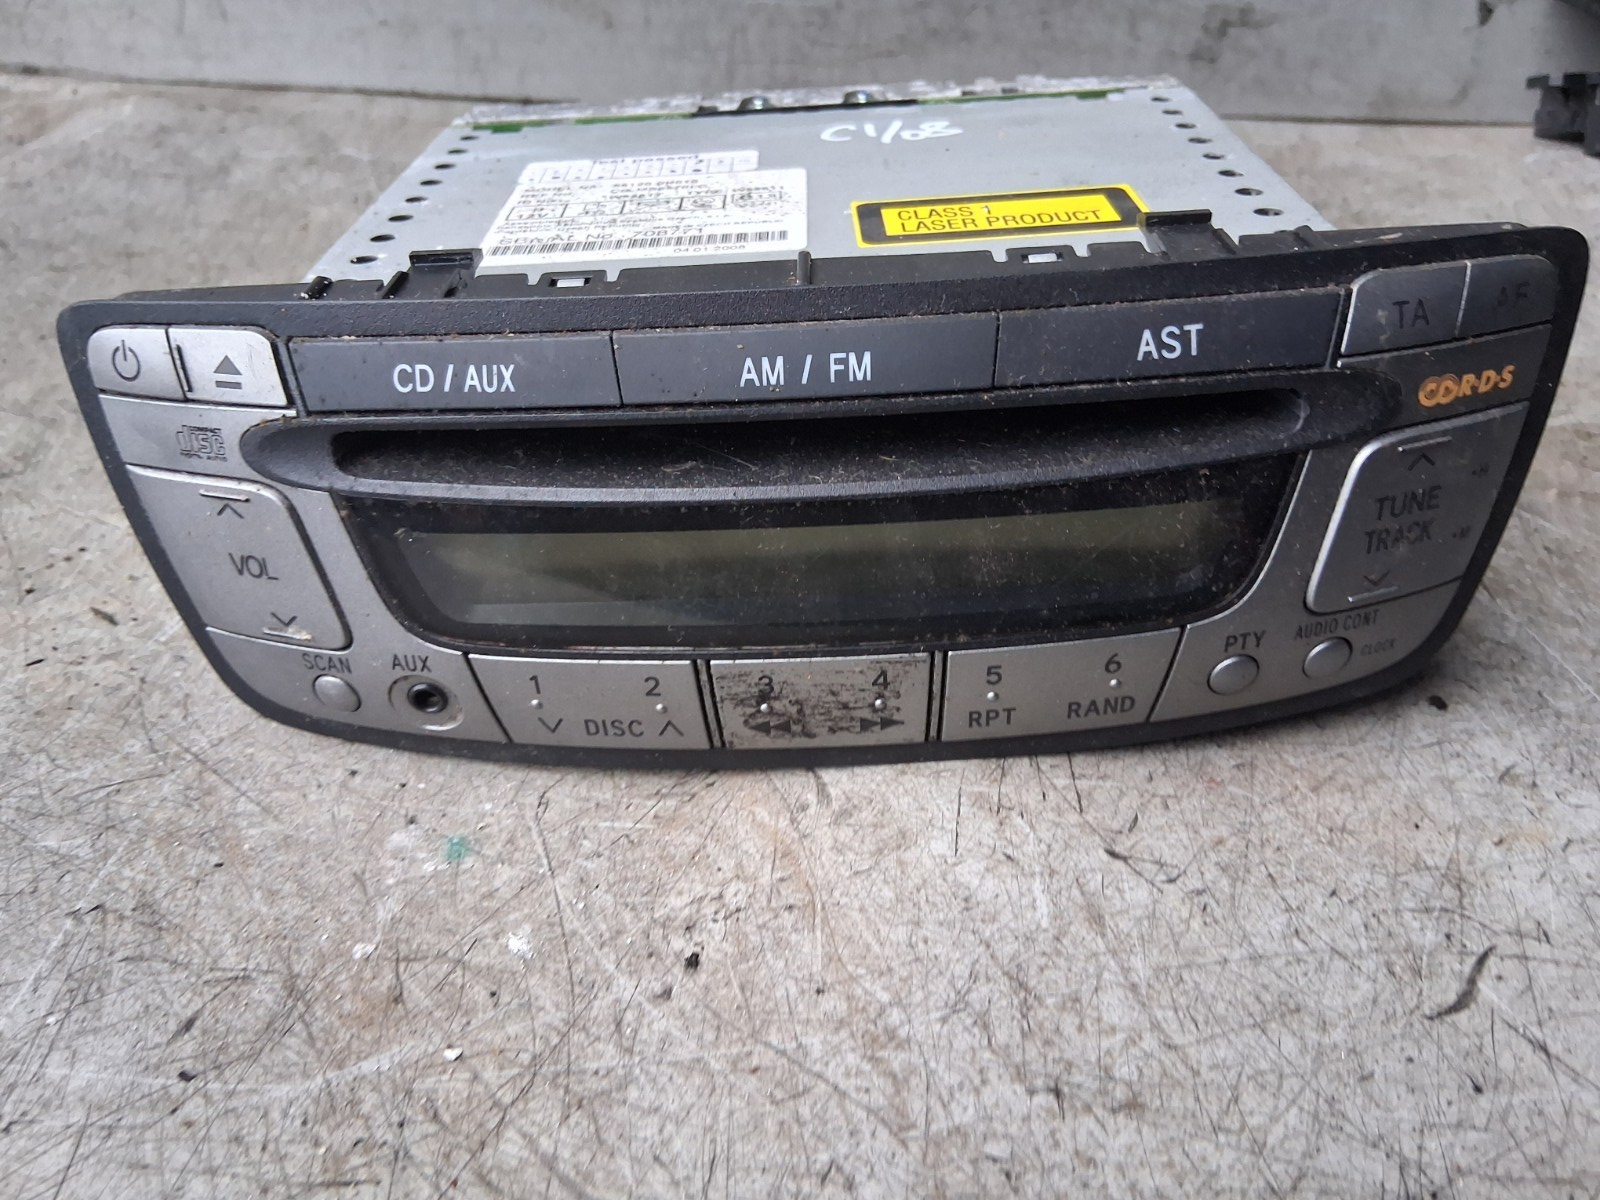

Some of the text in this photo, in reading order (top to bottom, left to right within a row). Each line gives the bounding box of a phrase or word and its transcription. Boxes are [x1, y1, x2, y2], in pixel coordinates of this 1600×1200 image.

[897, 204, 992, 222] CLASS 1
[900, 208, 1102, 234] LASER PRODUCT
[1391, 298, 1430, 330] TA
[1137, 323, 1205, 362] AST
[392, 363, 517, 394] CD / AUX
[739, 351, 873, 388] AM / FM
[1374, 485, 1443, 521] TUNE
[1364, 520, 1435, 555] TRACK
[228, 552, 280, 581] VOL
[1294, 608, 1380, 641] AUDIO CONT
[1224, 629, 1267, 652] PTY
[1360, 638, 1396, 657] CLOCK
[302, 653, 353, 675] SCAN
[392, 653, 433, 674] AUX
[1104, 653, 1122, 674] 6
[528, 674, 542, 696] 1
[758, 674, 774, 696] 3
[871, 669, 890, 691] 4
[985, 664, 1003, 686] 5
[644, 676, 662, 697] 2
[967, 707, 1017, 729] RPT
[1066, 695, 1136, 719] RAND
[584, 718, 645, 738] DISC
